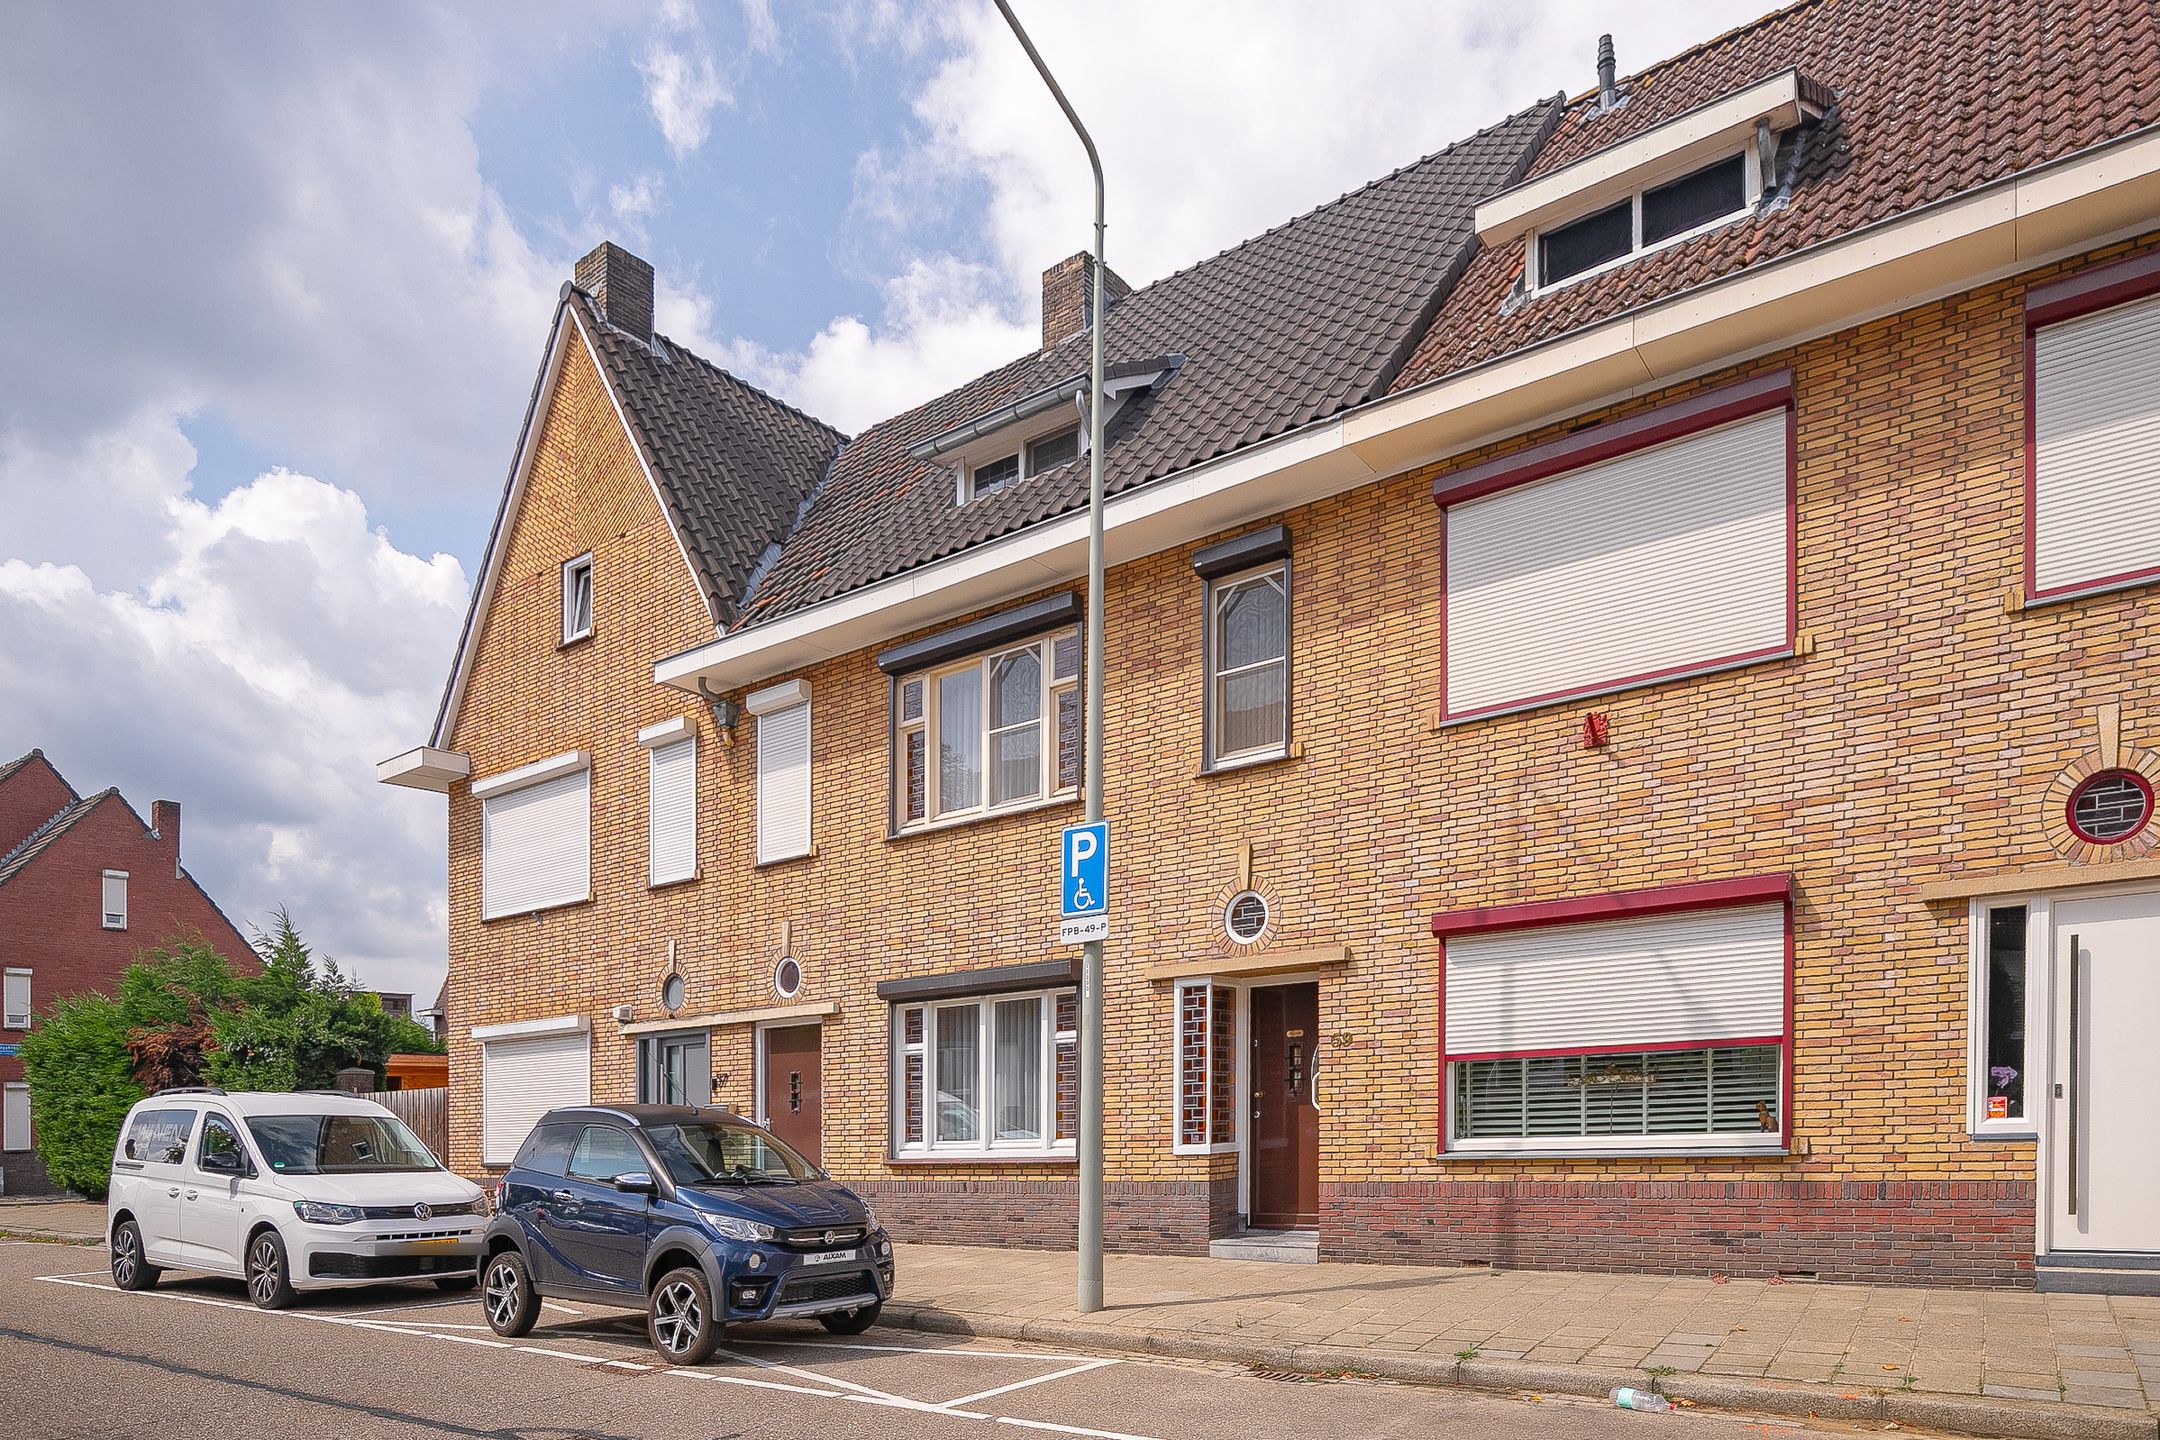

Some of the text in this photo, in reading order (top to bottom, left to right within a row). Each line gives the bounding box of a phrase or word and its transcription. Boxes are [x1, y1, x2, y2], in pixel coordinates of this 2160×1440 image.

[1071, 831, 1098, 877] P
[1062, 922, 1107, 937] FPB-49-P
[823, 1252, 847, 1261] AIXAM
